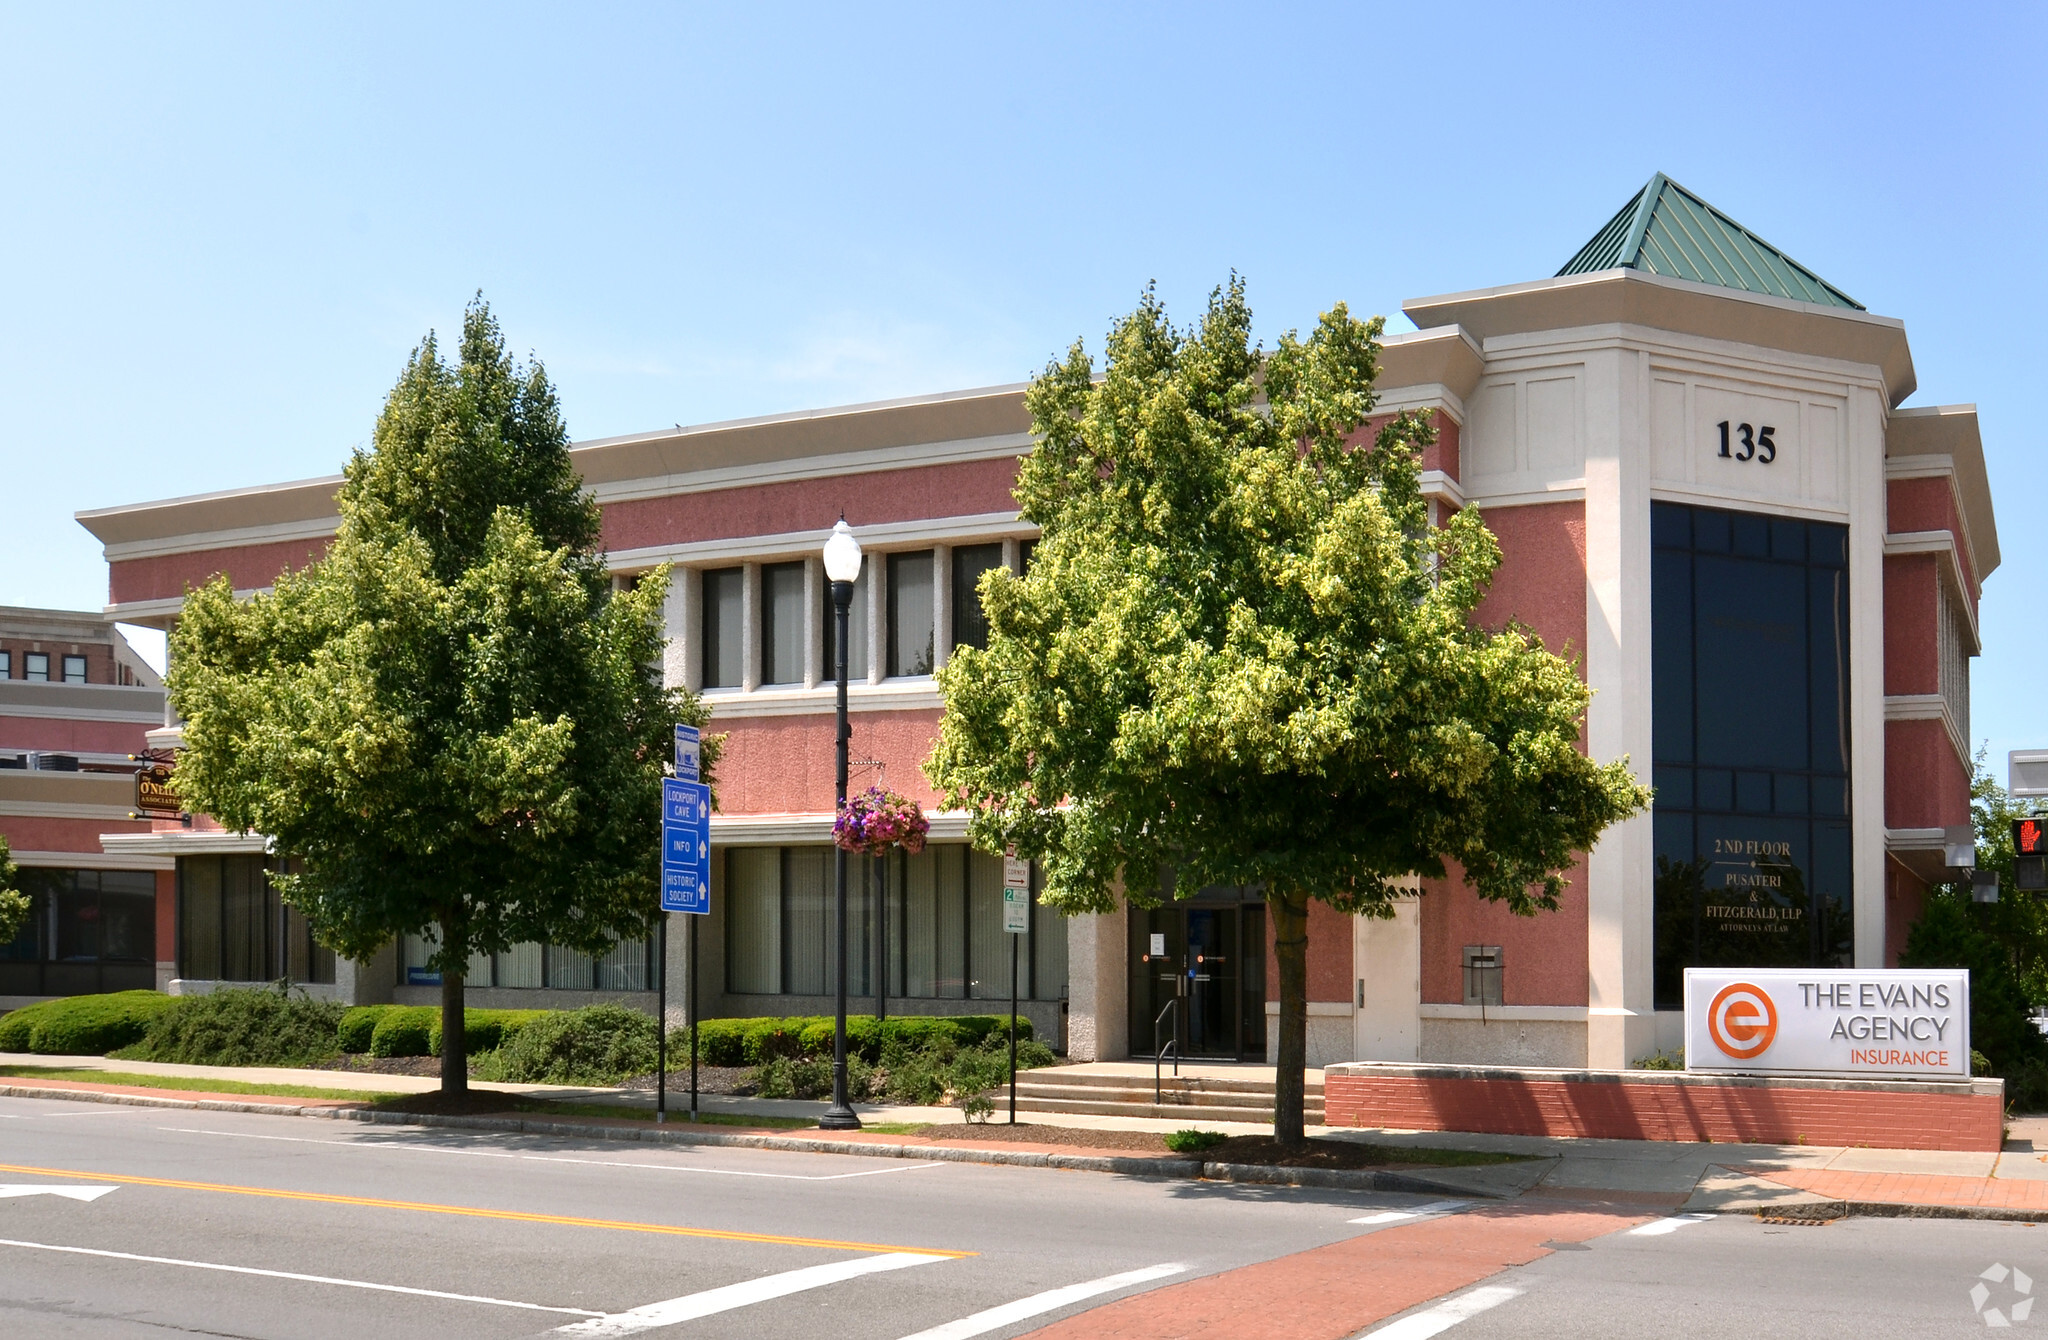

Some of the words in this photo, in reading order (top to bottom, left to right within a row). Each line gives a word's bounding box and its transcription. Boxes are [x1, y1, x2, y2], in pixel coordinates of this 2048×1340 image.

[1717, 420, 1776, 464] 135
[677, 765, 698, 776] LOCKPORT
[669, 789, 696, 805] LOCKPORT
[675, 805, 690, 818] CAVE
[674, 840, 690, 853] INFO
[1746, 841, 1791, 856] FLOOR
[667, 875, 695, 888] HISTORIC
[1726, 873, 1781, 887] PUSATERI
[669, 890, 693, 903] SOCIETY
[1006, 889, 1012, 901] 2
[1750, 891, 1758, 902] &
[1706, 905, 1780, 920] FITZGERALD,
[1782, 907, 1802, 920] LLP
[1720, 924, 1762, 932] ATTORNEYS
[1764, 924, 1774, 932] AT
[1774, 925, 1789, 933] LAW
[1799, 983, 1851, 1007] THE
[1859, 984, 1950, 1008] EVANS
[1830, 1016, 1950, 1042] AGENCY
[1850, 1049, 1949, 1066] INSURANCE
